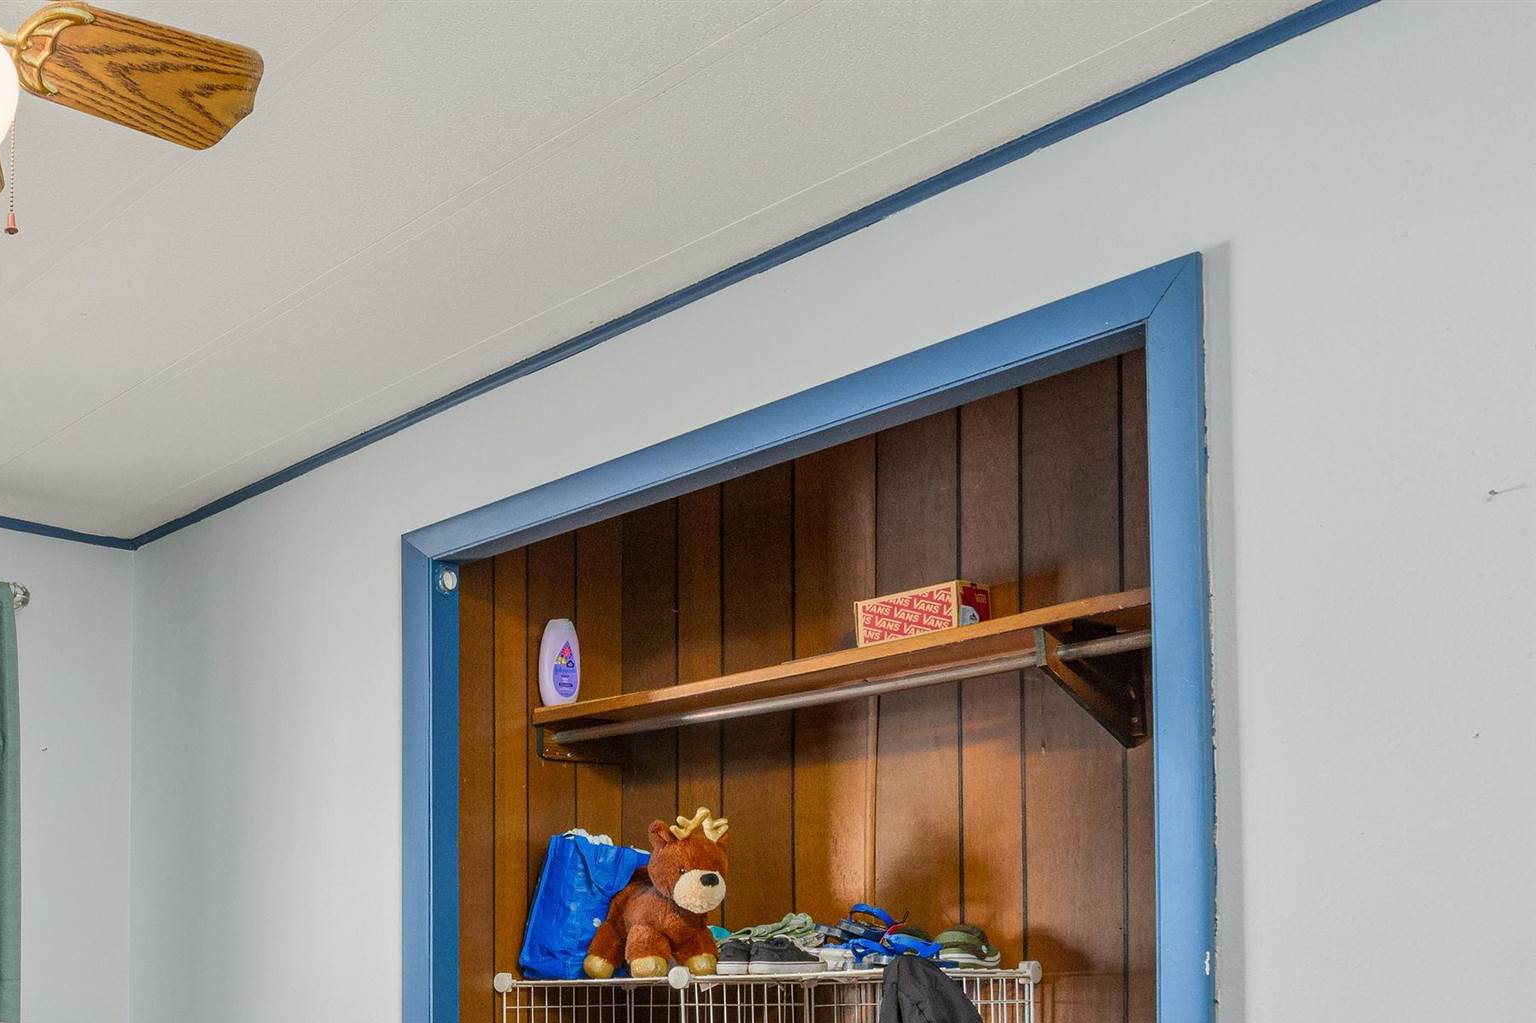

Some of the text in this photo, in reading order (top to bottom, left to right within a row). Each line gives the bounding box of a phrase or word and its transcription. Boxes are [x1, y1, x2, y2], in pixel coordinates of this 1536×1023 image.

[933, 590, 952, 602] VAN
[913, 598, 942, 614] VANS
[864, 603, 951, 629] VANS VANS VANS
[864, 626, 883, 640] ANS
[875, 615, 902, 632] VANS
[903, 622, 932, 636] VAN
